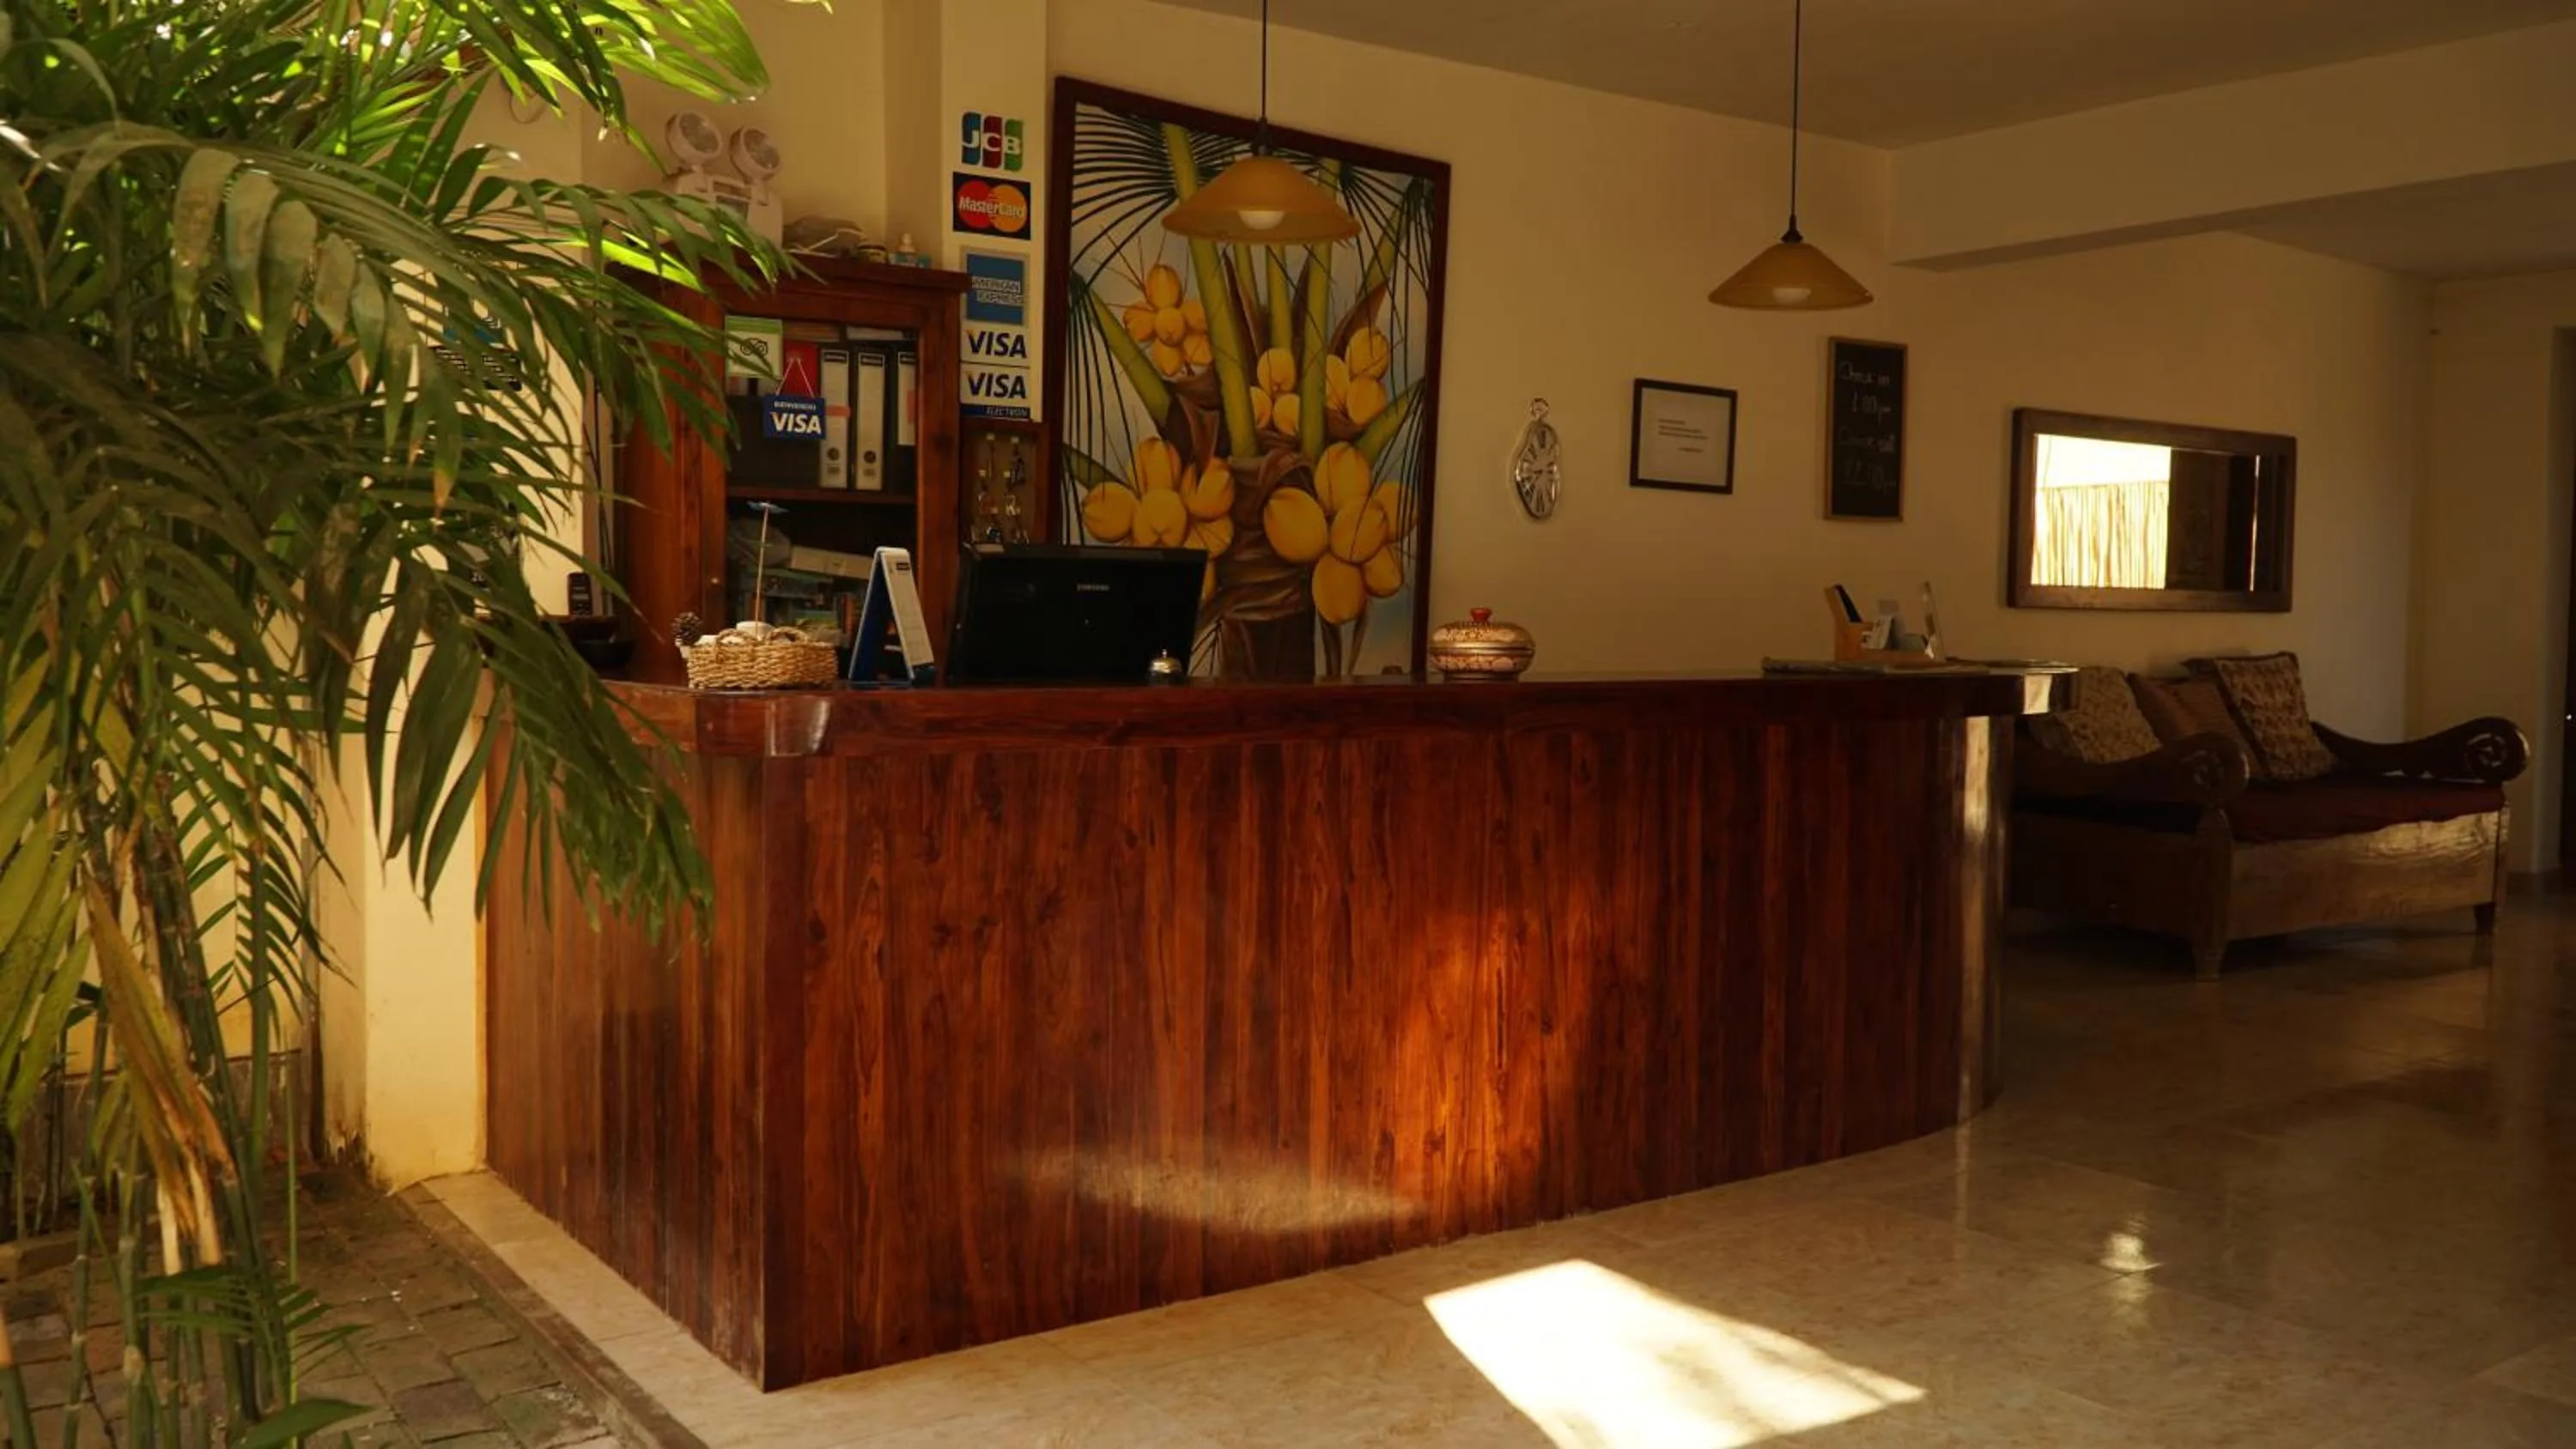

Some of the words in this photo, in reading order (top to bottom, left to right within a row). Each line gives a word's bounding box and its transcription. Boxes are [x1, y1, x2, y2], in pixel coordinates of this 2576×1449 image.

[959, 197, 1024, 217] MasterCard
[966, 330, 1027, 359] VISA
[966, 371, 1026, 399] VISA
[769, 411, 822, 435] VISA
